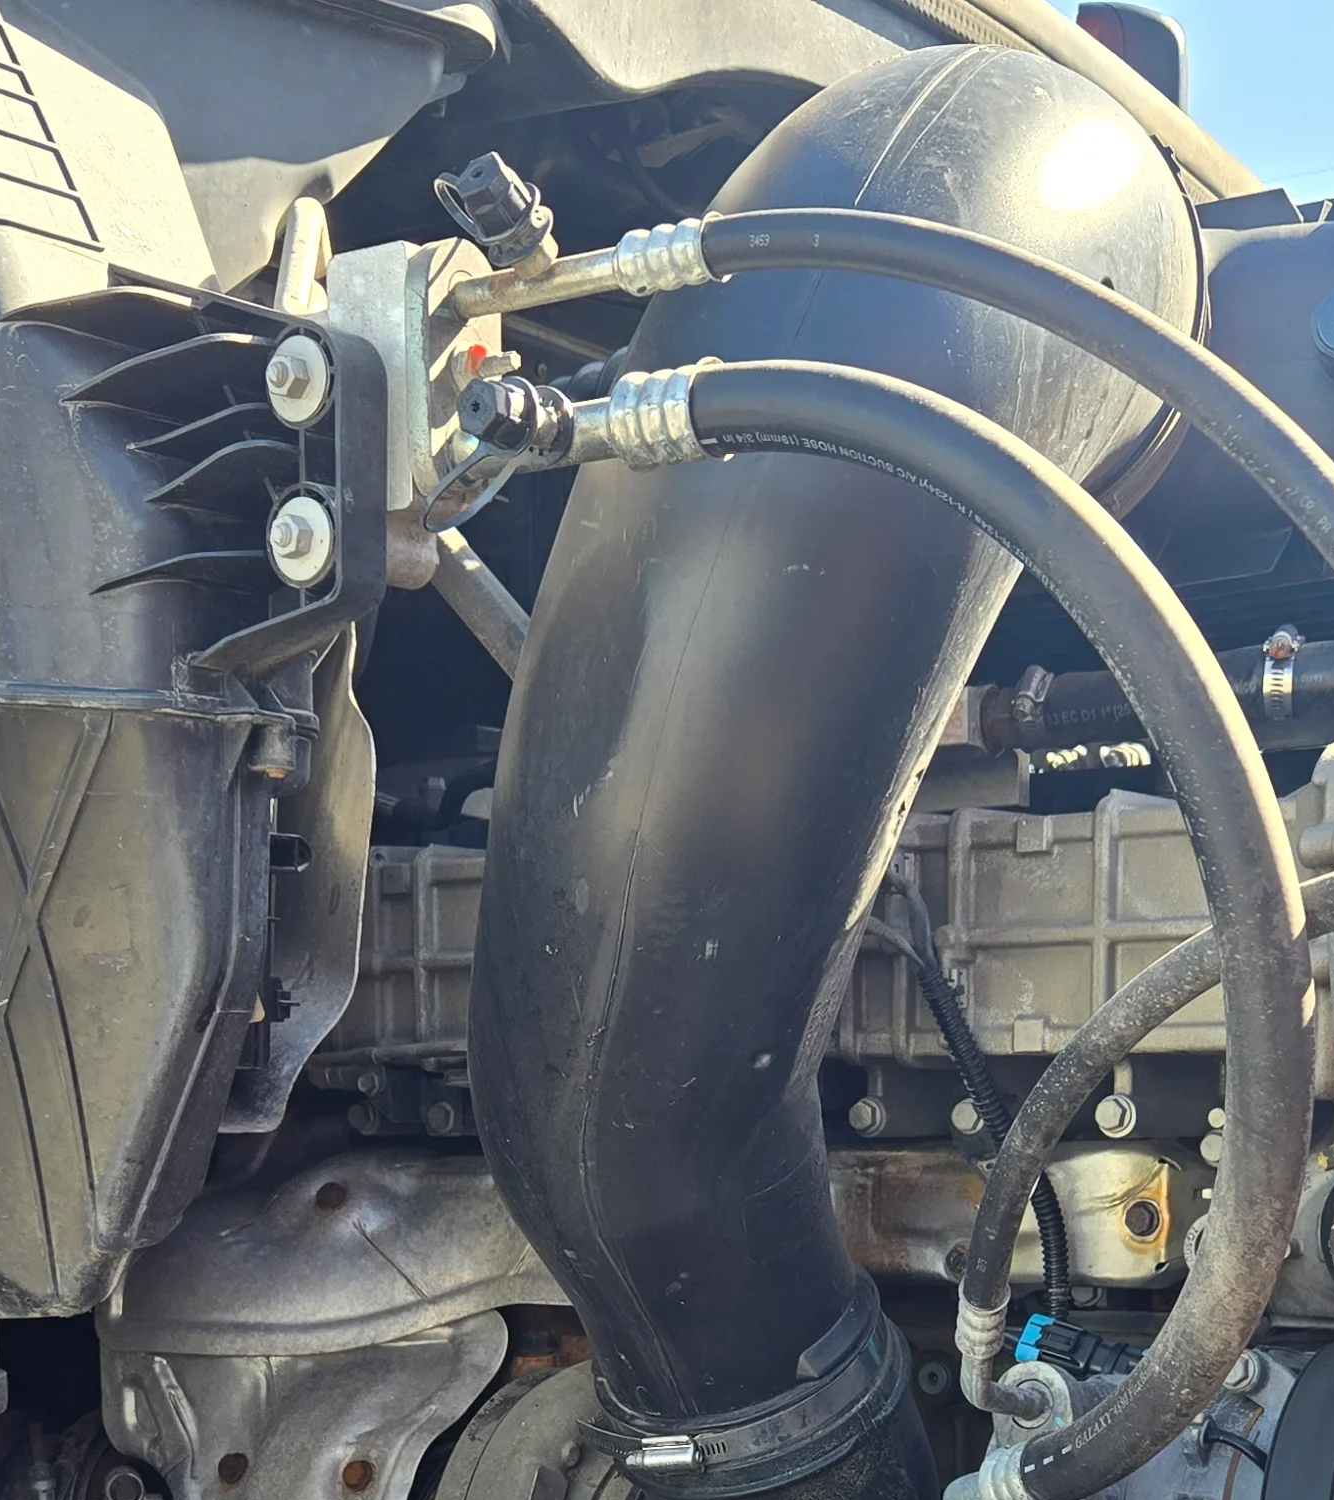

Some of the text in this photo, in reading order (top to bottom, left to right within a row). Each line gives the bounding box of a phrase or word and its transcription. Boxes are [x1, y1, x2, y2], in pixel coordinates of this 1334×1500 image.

[756, 431, 799, 446] (19mm)
[802, 437, 836, 454] HOSE
[838, 446, 894, 473] SUCTION
[896, 467, 917, 483] A/C
